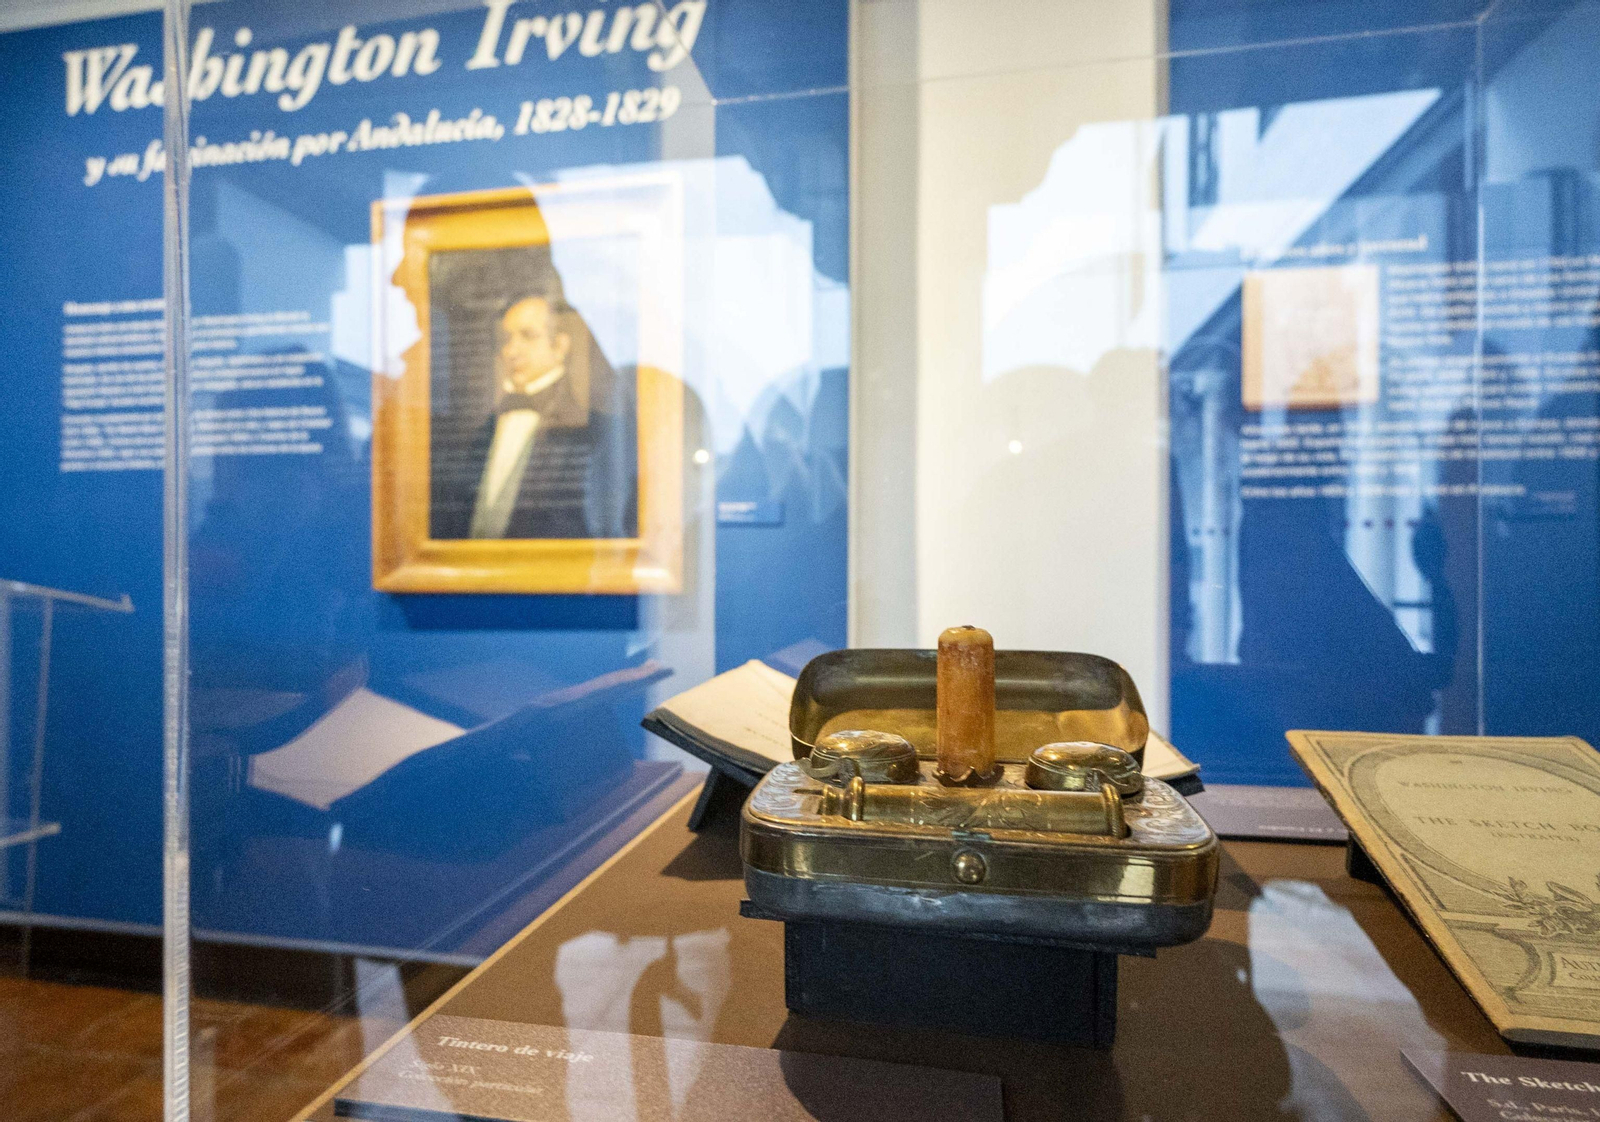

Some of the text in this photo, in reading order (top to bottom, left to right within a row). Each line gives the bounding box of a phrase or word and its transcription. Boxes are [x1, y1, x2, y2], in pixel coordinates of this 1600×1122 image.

[63, 0, 707, 117] Wahington Irving
[84, 157, 106, 187] y
[138, 130, 290, 182] fainación
[290, 131, 348, 167] por
[347, 107, 505, 153] Andalucía,
[513, 85, 681, 136] 1828-1829
[1413, 815, 1458, 826] THE
[1468, 818, 1557, 832] SKETCH
[435, 1035, 595, 1065] Tintero de viaje
[1460, 1070, 1600, 1093] The Sketch
